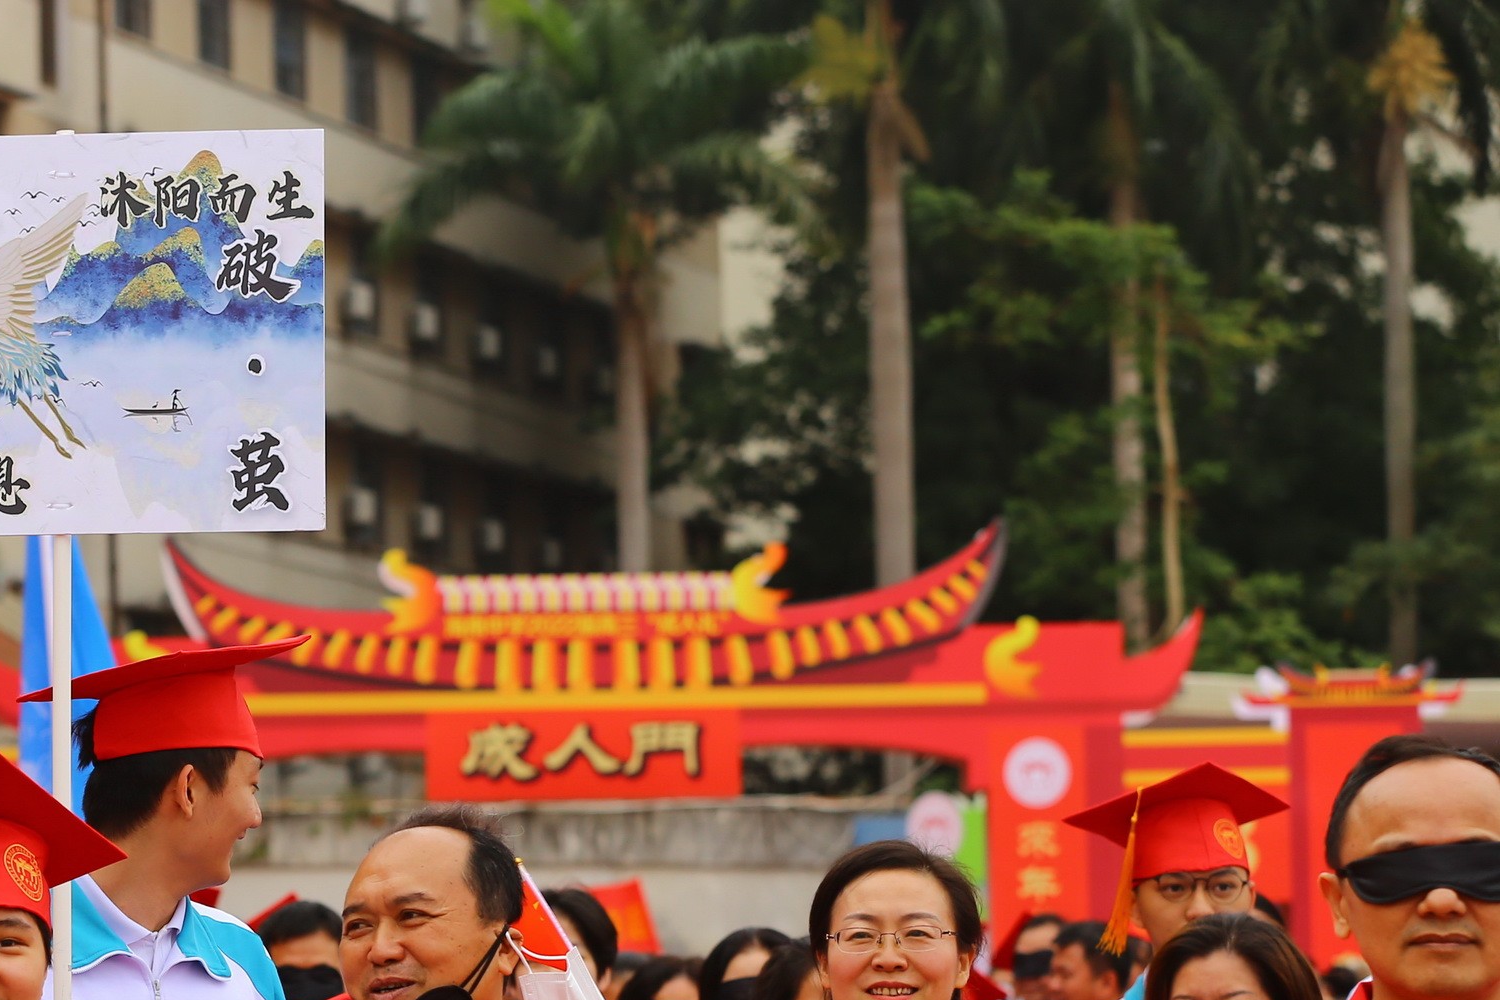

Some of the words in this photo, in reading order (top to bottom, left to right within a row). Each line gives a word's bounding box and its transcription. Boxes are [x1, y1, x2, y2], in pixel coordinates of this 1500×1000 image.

[100, 169, 315, 228] 沐阳而生
[460, 720, 700, 781] 成人門
